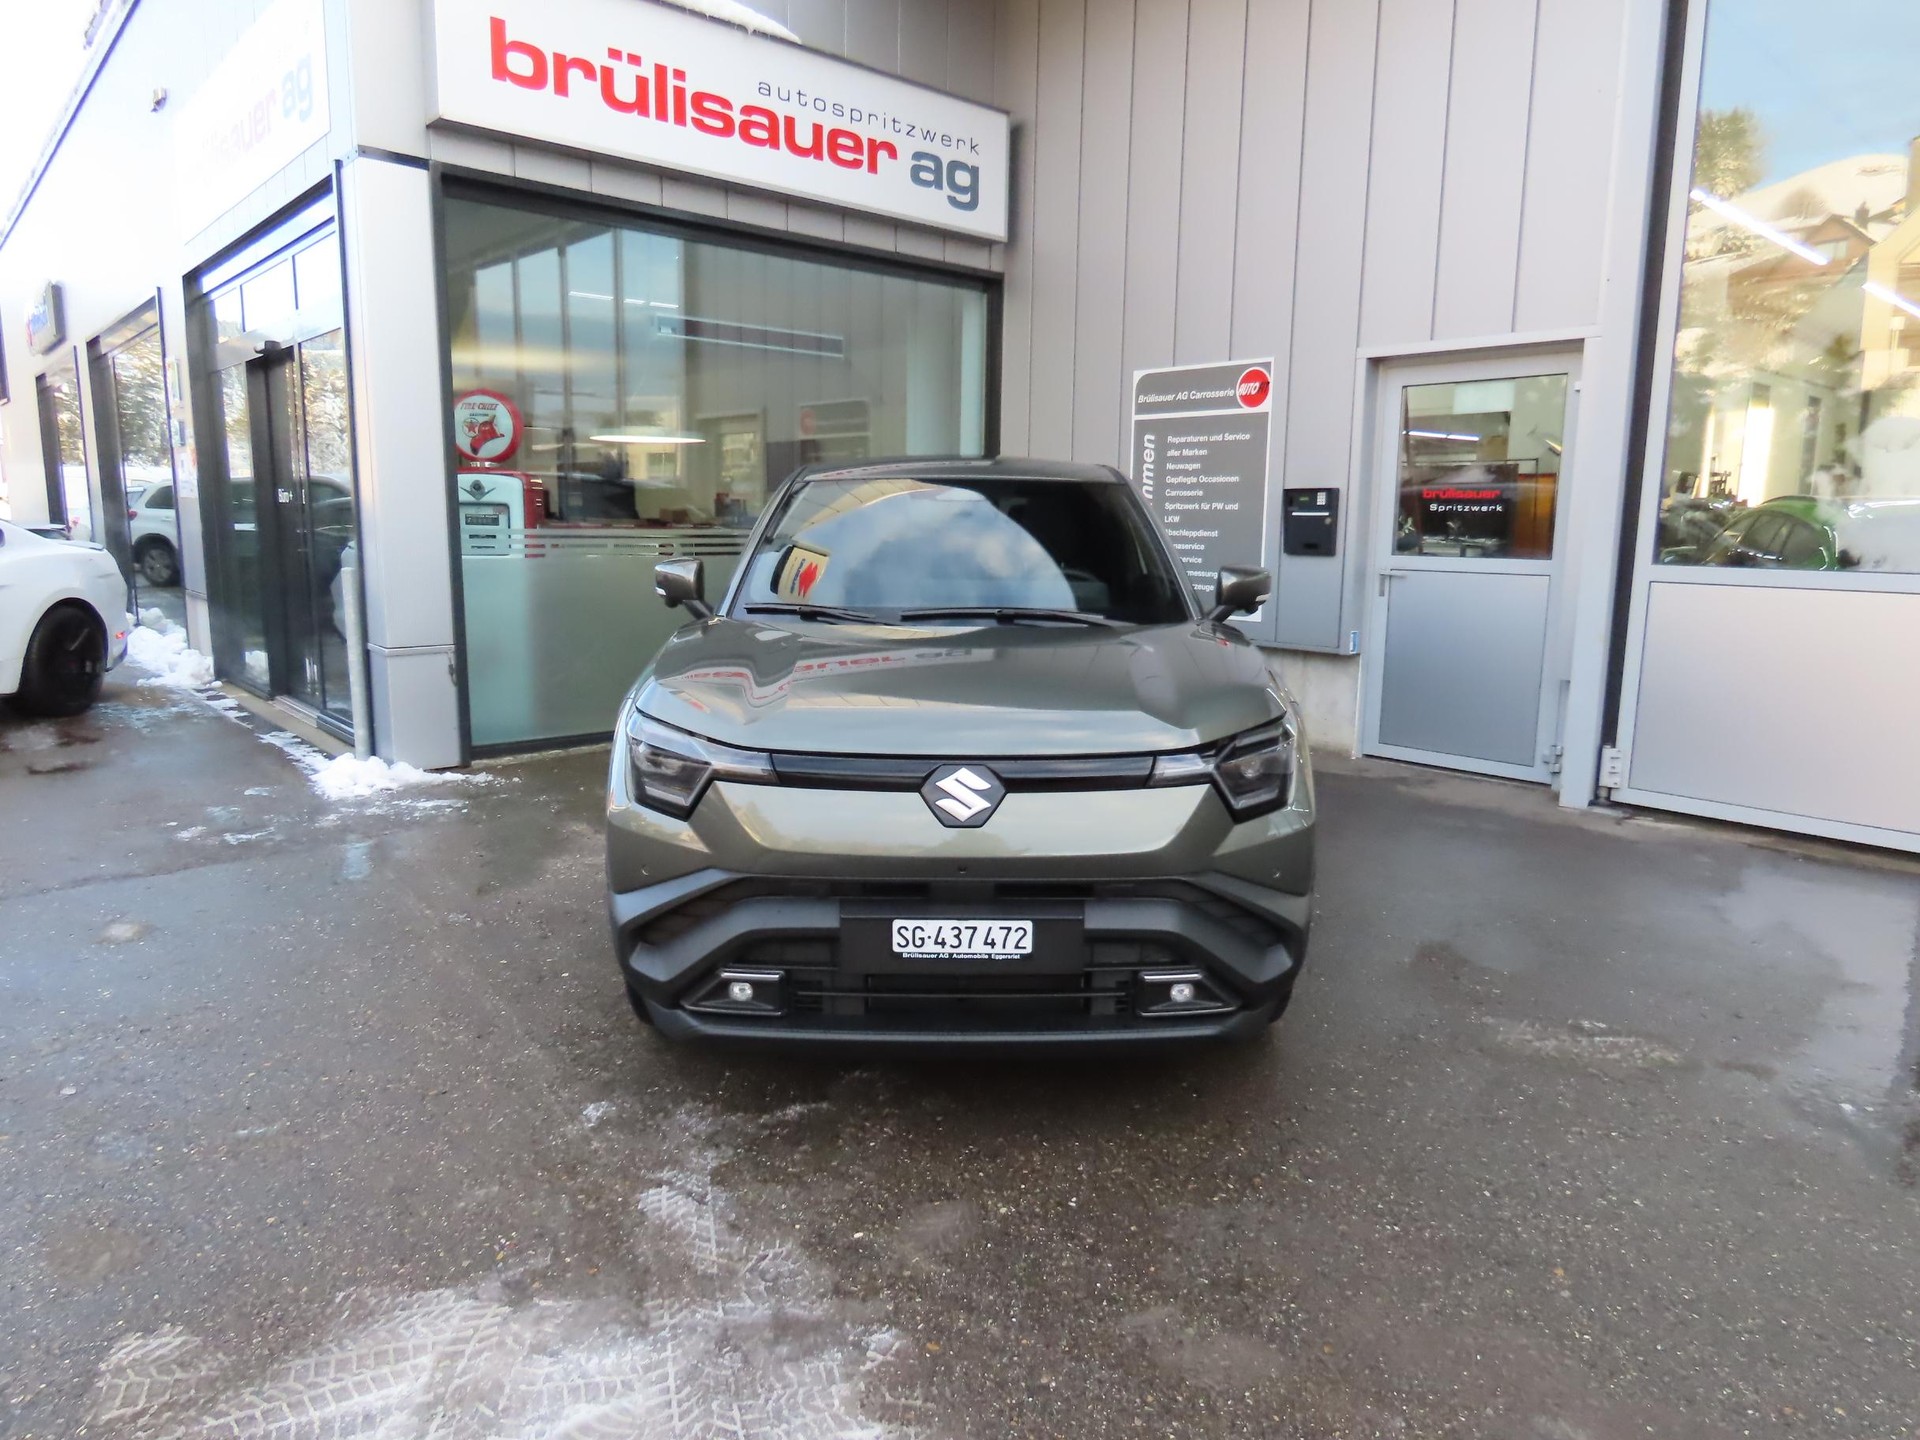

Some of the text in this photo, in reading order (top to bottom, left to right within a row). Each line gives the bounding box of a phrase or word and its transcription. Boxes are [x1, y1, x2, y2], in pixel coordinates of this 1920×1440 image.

[489, 16, 980, 212] brülisauer ag
[757, 81, 980, 156] autospritzwerk
[1137, 387, 1235, 403] Brülisauer AG Carrosserie
[1167, 432, 1251, 445] Reparaturen und Service
[1182, 448, 1208, 457] Marken
[1166, 462, 1201, 471] Neuwagen
[1165, 474, 1240, 485] Gepflegte Occasionen
[1165, 488, 1204, 497] Carrosserie
[1164, 502, 1239, 511] Spritzwerk für PW und
[1429, 503, 1503, 512] Spritzwerk
[1164, 515, 1180, 523] LKW
[1165, 528, 1218, 538] bschleppdienst
